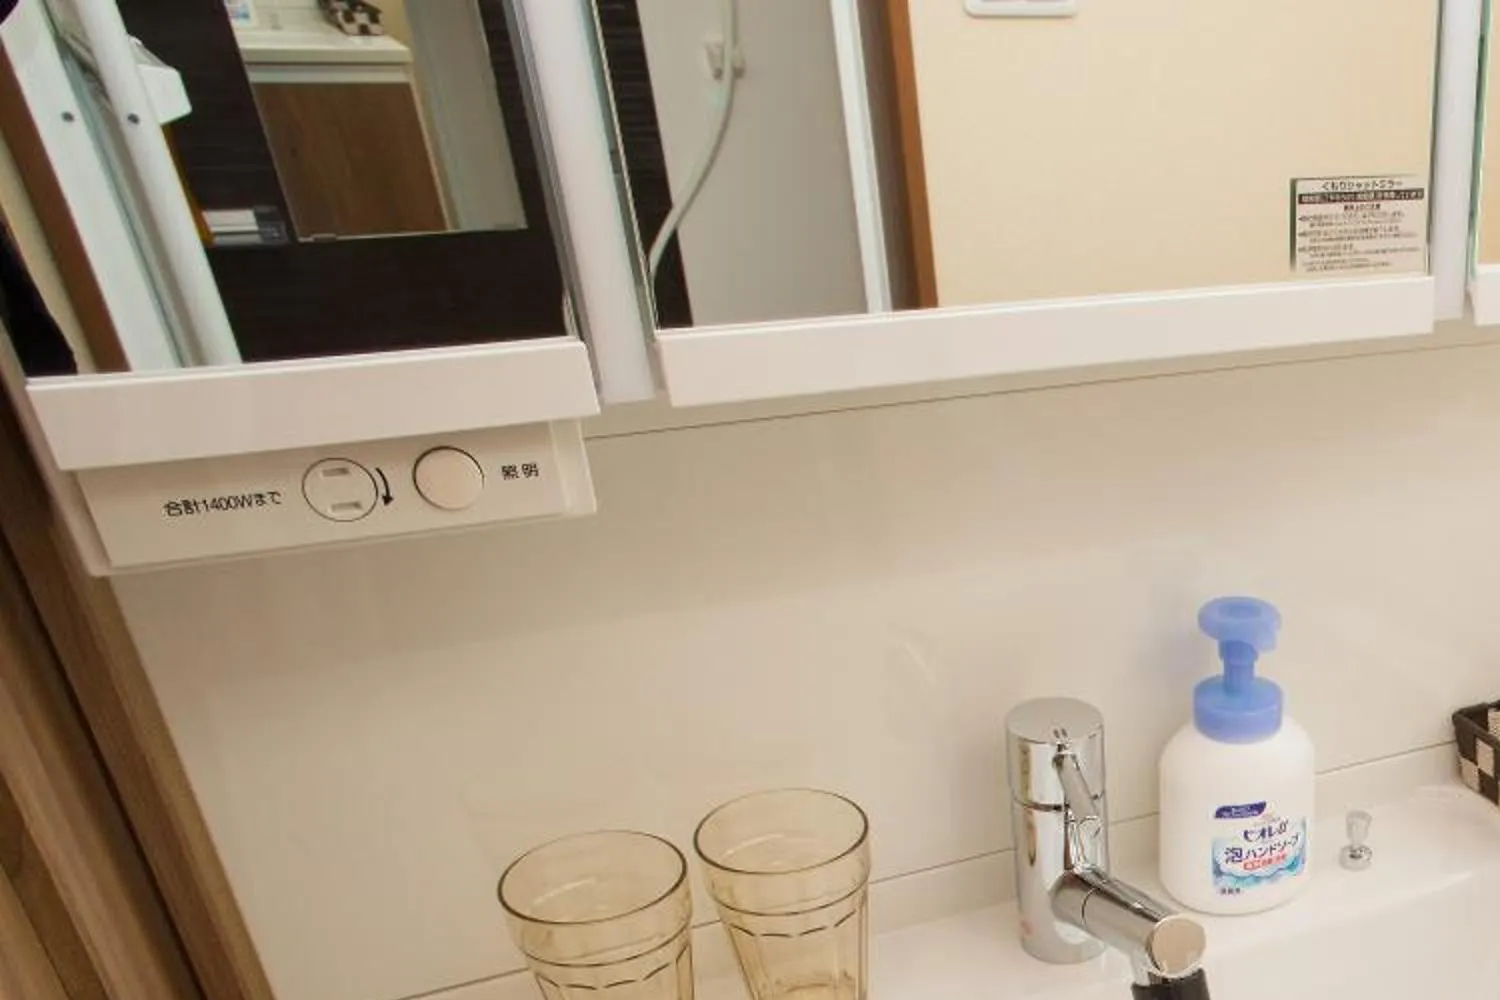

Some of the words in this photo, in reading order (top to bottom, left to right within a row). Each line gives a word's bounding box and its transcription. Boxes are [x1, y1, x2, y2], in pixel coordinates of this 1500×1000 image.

[1225, 834, 1299, 865] 泡ハンドソープ
